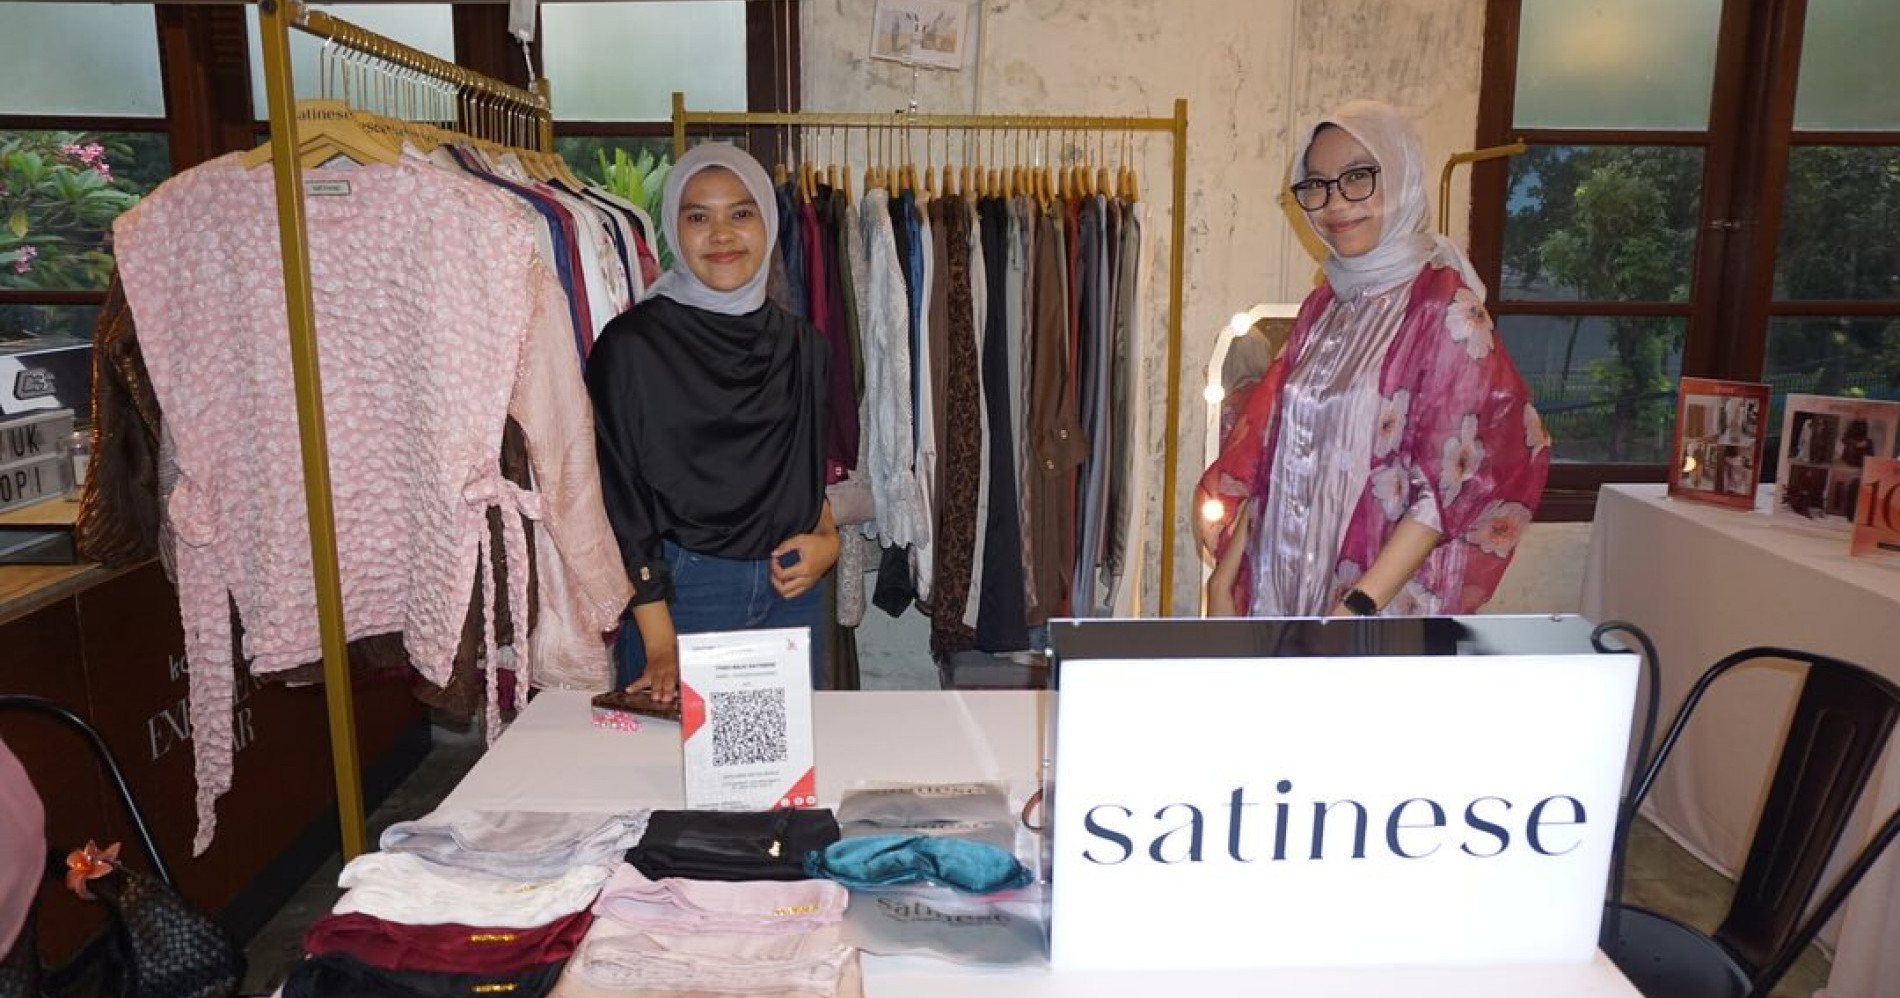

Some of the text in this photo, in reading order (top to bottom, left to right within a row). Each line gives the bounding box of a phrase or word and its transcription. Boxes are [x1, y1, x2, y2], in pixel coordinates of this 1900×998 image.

[296, 107, 353, 121] atinese
[0, 424, 39, 460] UK
[1082, 779, 1587, 865] satinese
